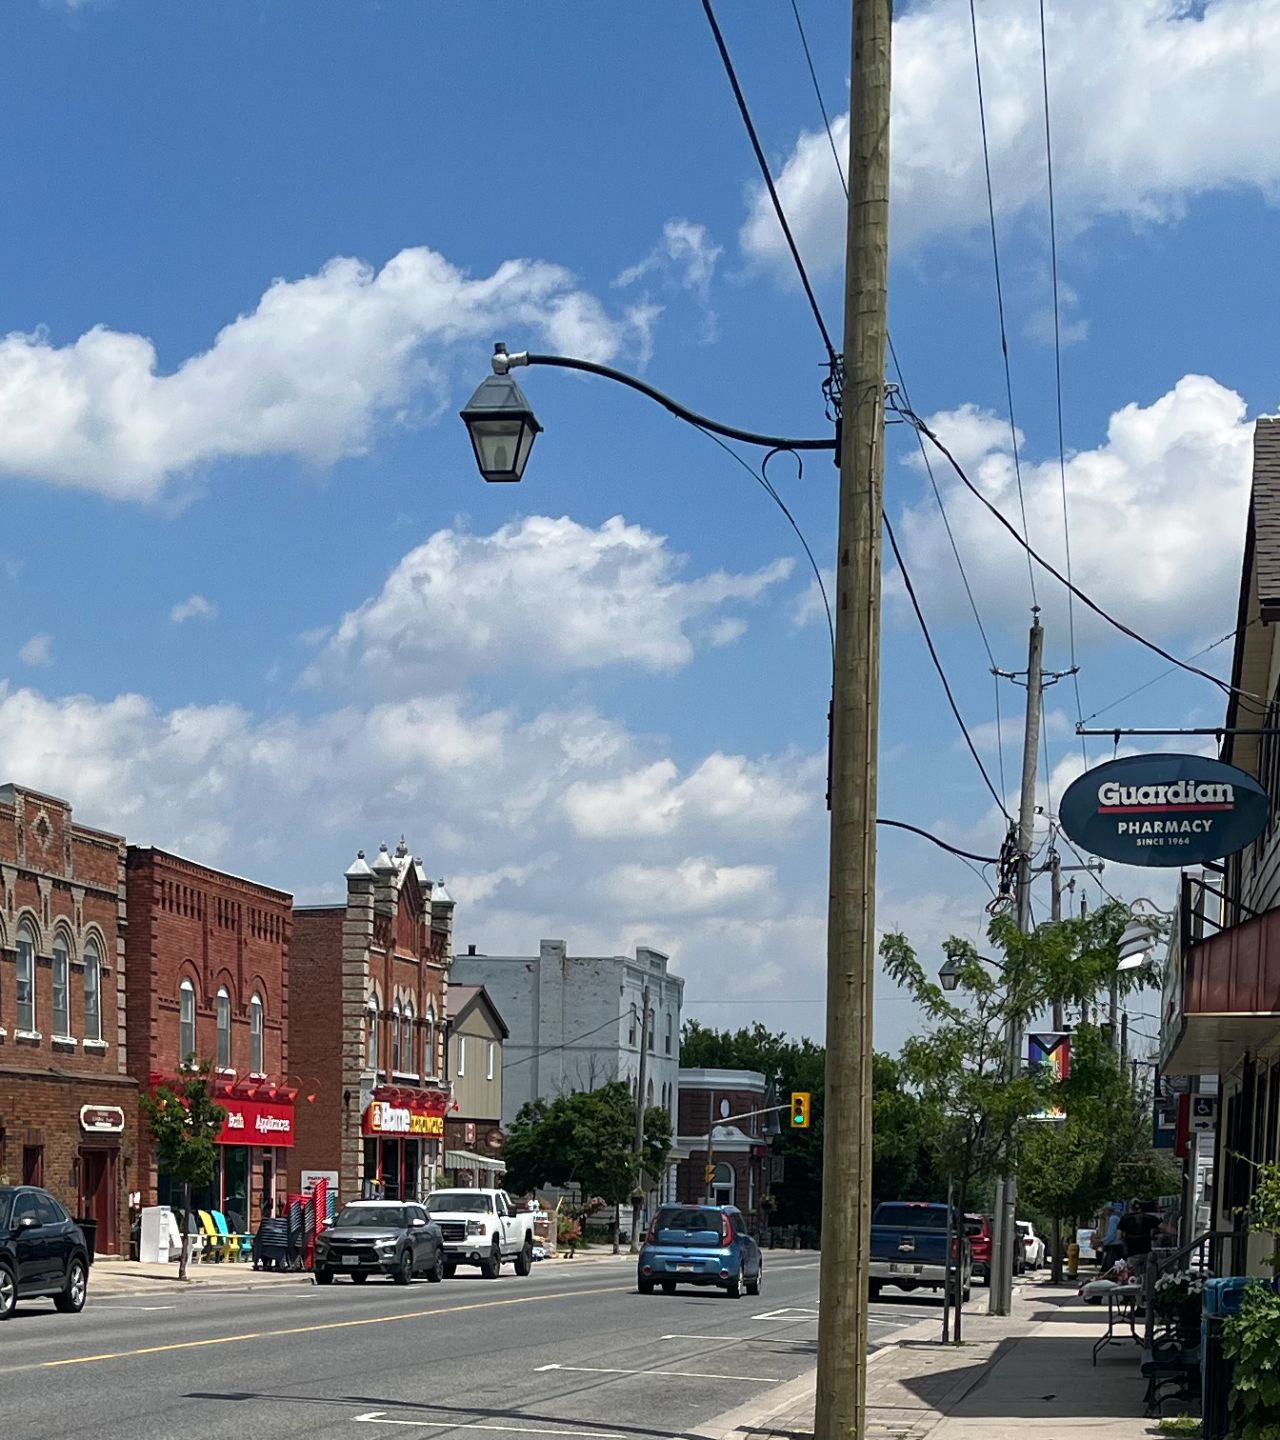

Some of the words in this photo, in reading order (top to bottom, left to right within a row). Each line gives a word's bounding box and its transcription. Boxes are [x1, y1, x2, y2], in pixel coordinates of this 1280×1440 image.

[1098, 781, 1235, 806] Guardian
[1118, 819, 1213, 834] PHARMACY
[1168, 837, 1190, 846] 1964
